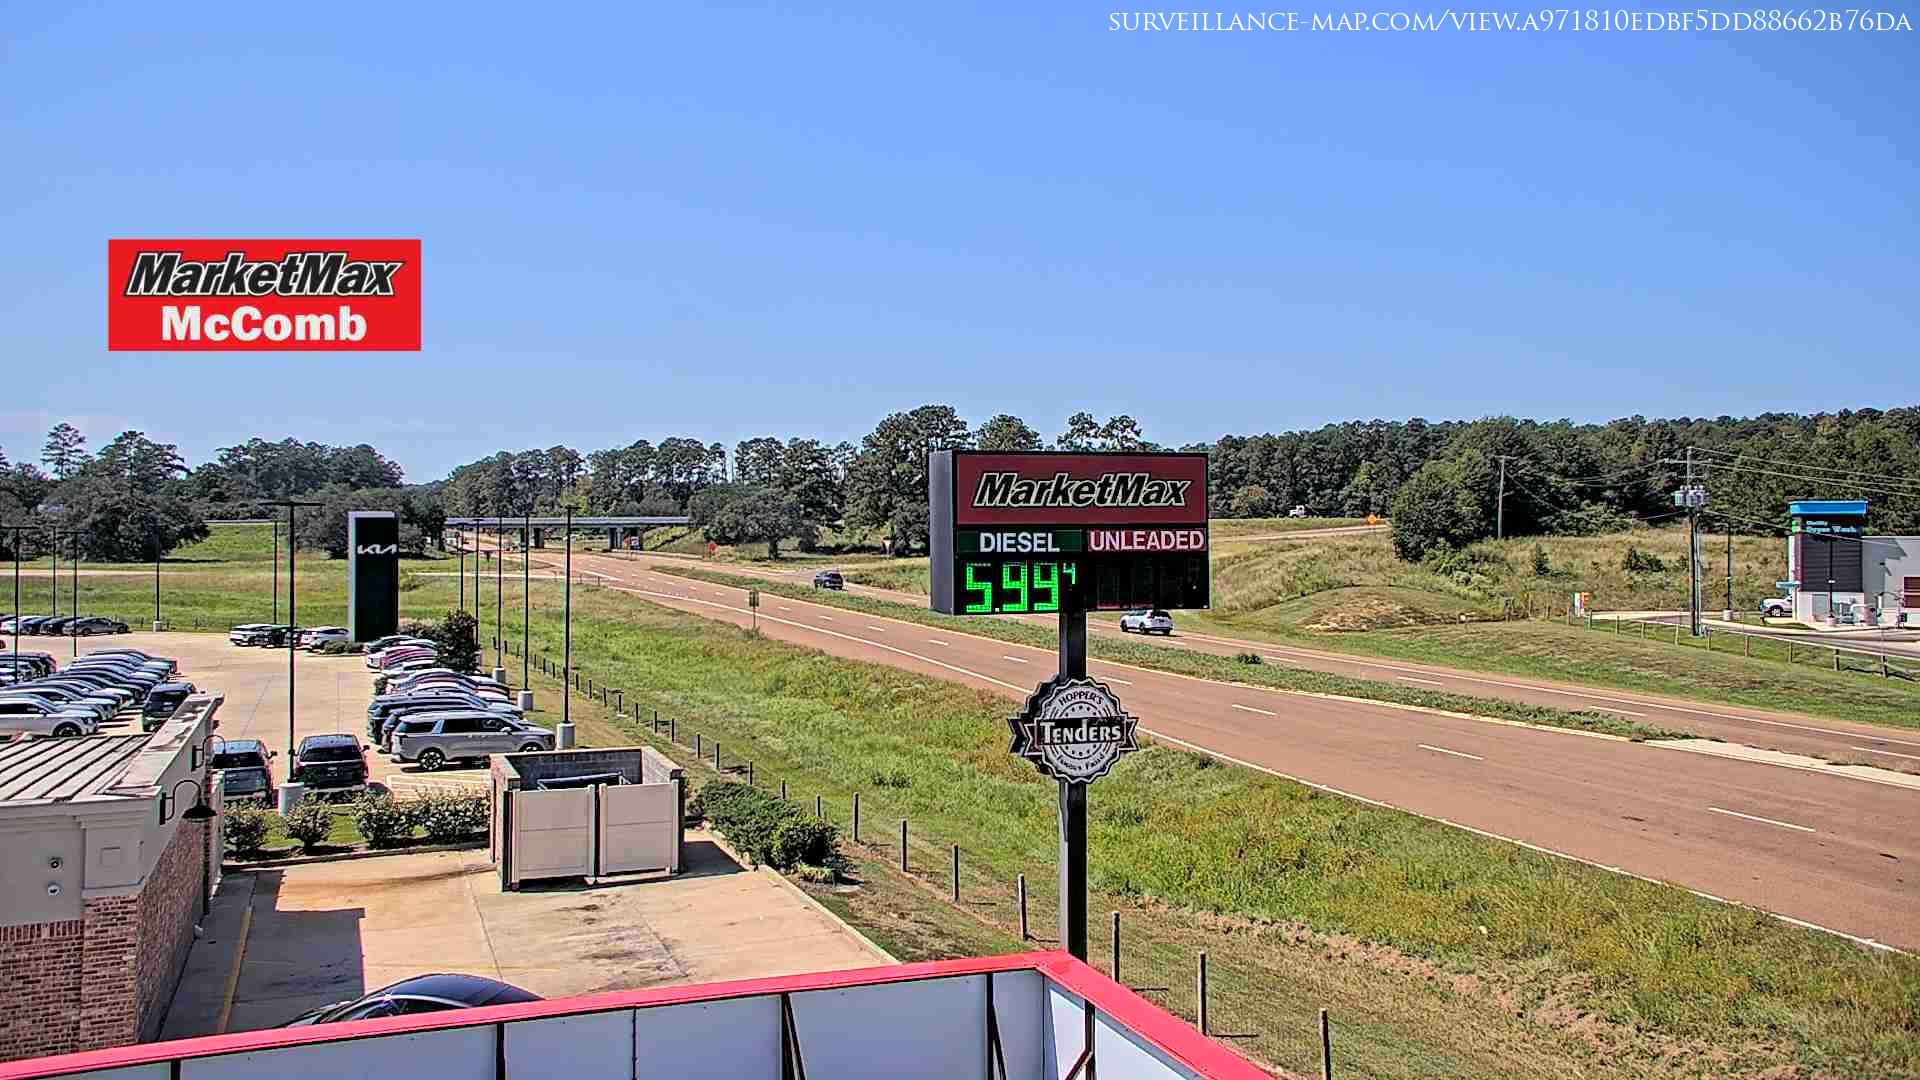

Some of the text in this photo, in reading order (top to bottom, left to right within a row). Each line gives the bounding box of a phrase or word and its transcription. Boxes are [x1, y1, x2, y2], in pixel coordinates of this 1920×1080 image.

[973, 472, 1191, 508] MarketMax
[979, 532, 1060, 553] DIESEL
[1089, 530, 1205, 551] UNLEADED
